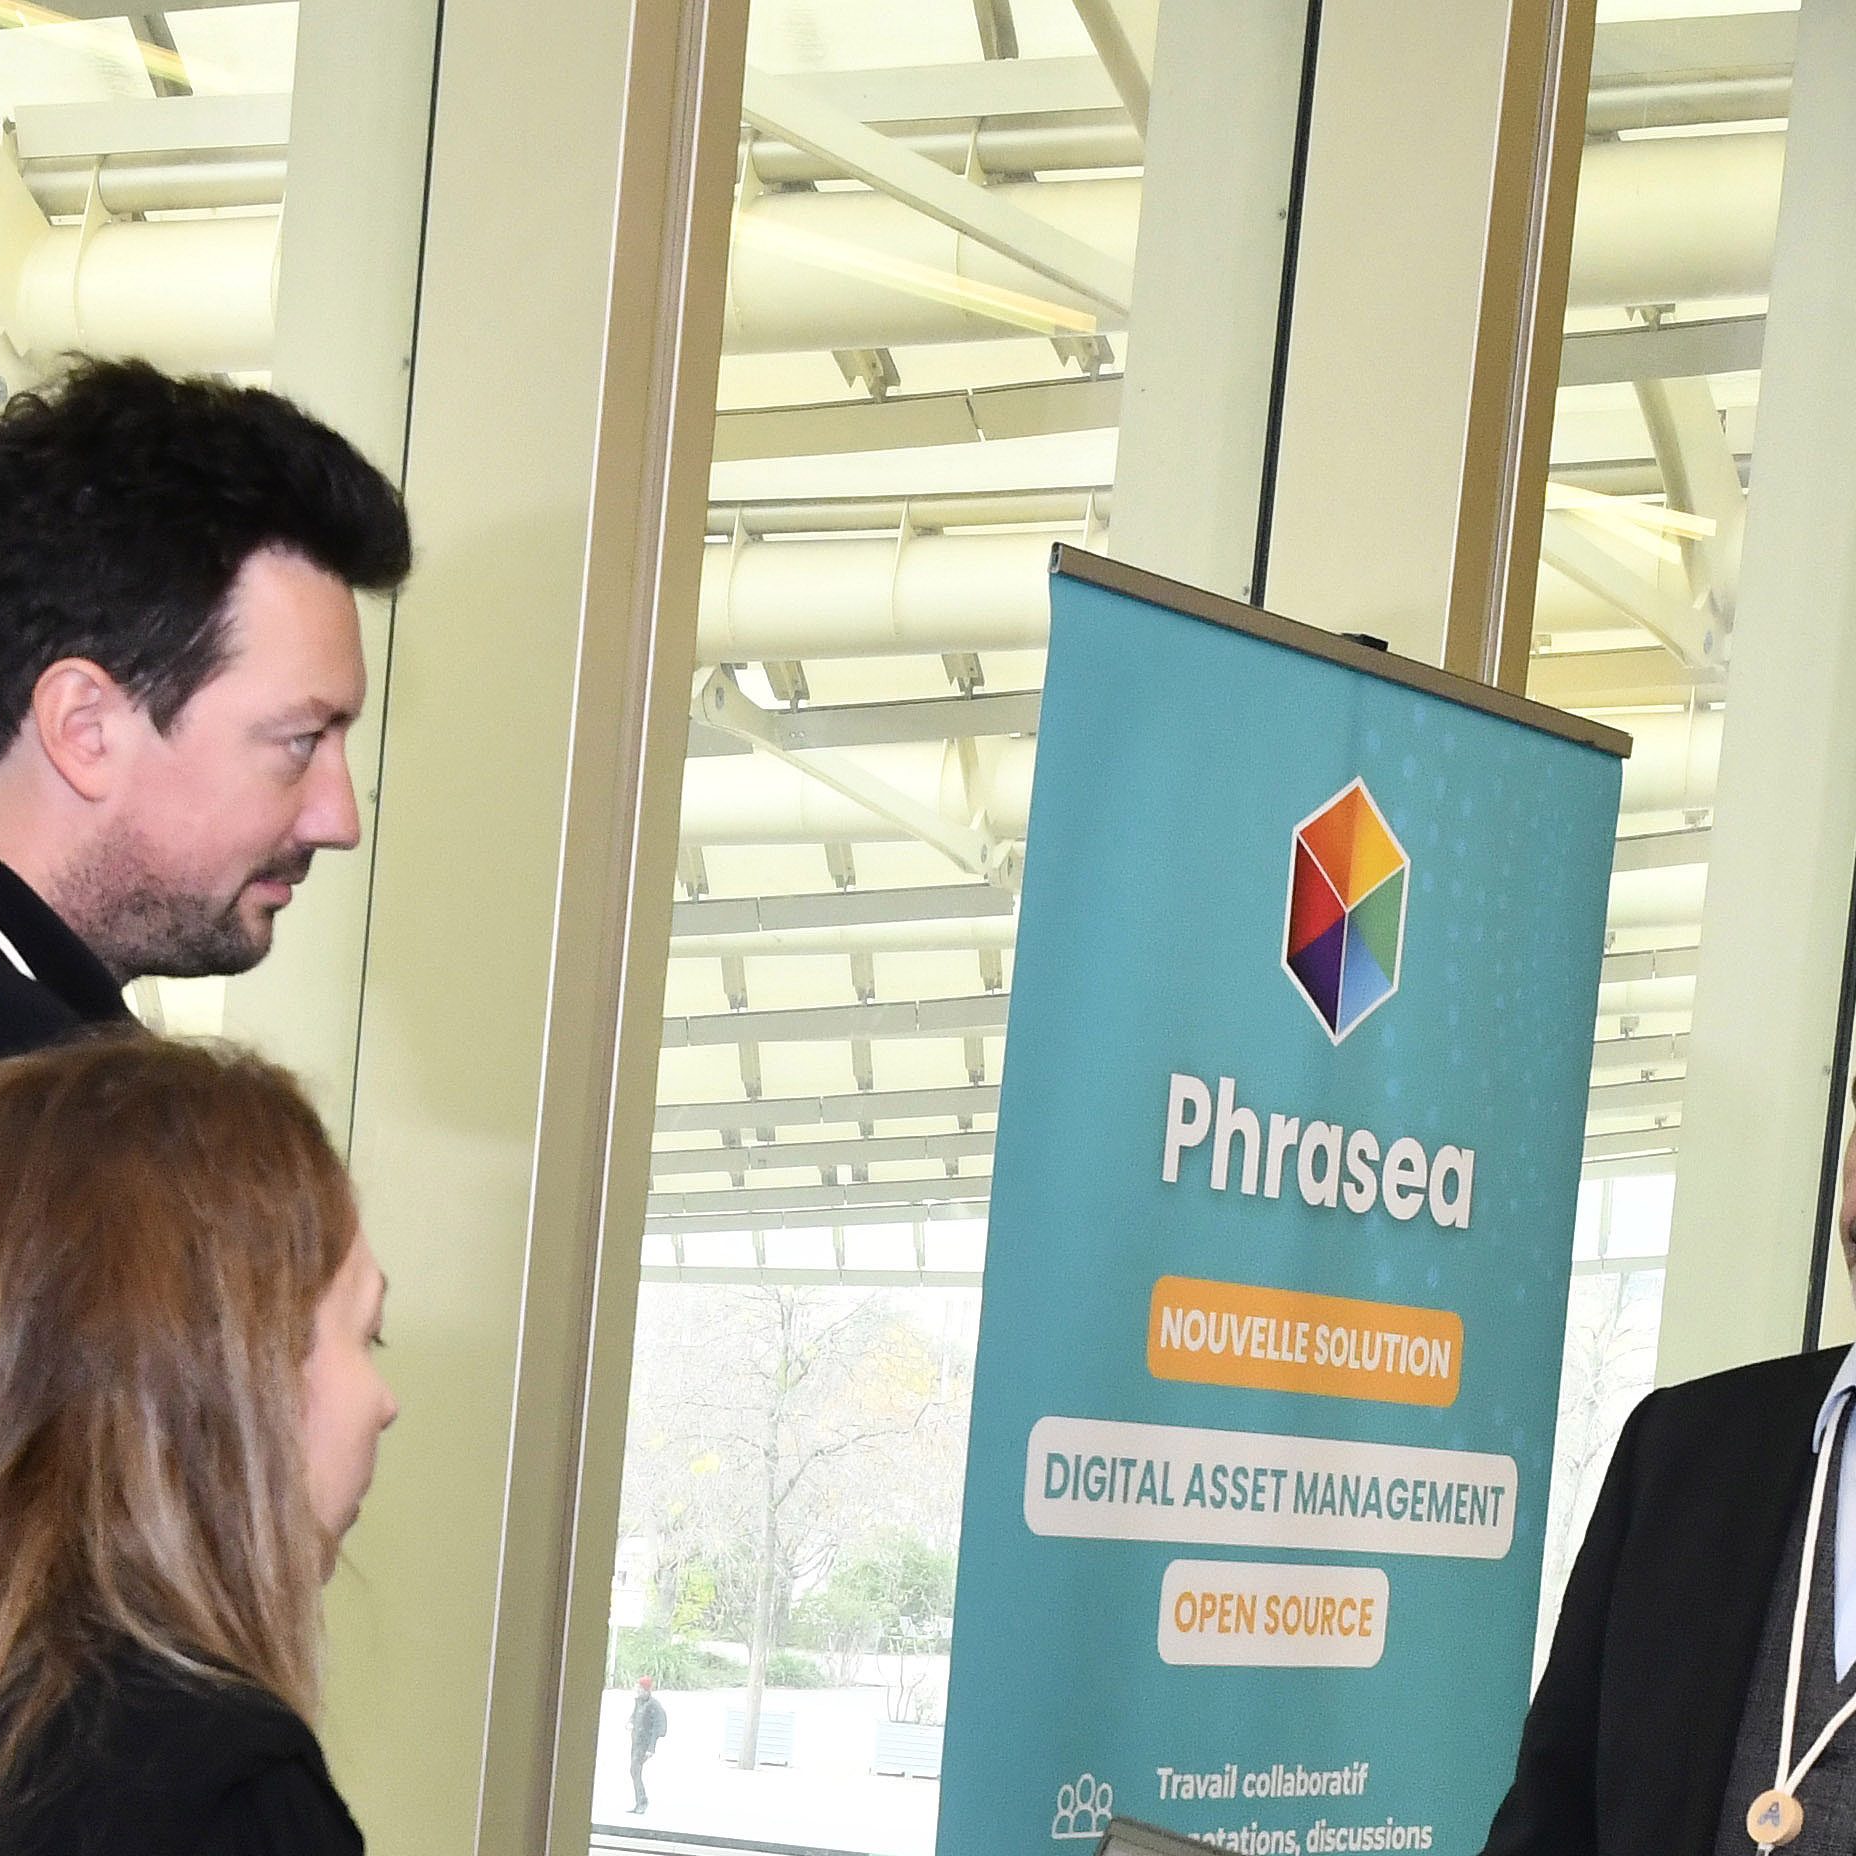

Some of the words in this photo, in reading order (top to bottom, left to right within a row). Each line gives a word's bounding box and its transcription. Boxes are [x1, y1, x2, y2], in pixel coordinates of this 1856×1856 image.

[1162, 1073, 1474, 1228] Phrasea
[1160, 1307, 1309, 1363] NOUVELLE
[1314, 1325, 1451, 1378] SOLUTION
[1044, 1453, 1174, 1506] DIGITAL
[1183, 1463, 1288, 1512] ASSET
[1293, 1471, 1505, 1527] MANAGEMENT
[1173, 1590, 1255, 1634] OPEN
[1265, 1593, 1374, 1638] SOURCE
[1157, 1764, 1237, 1799] Travail
[1242, 1762, 1369, 1798] collaboratif
[1306, 1817, 1432, 1853] discussions
